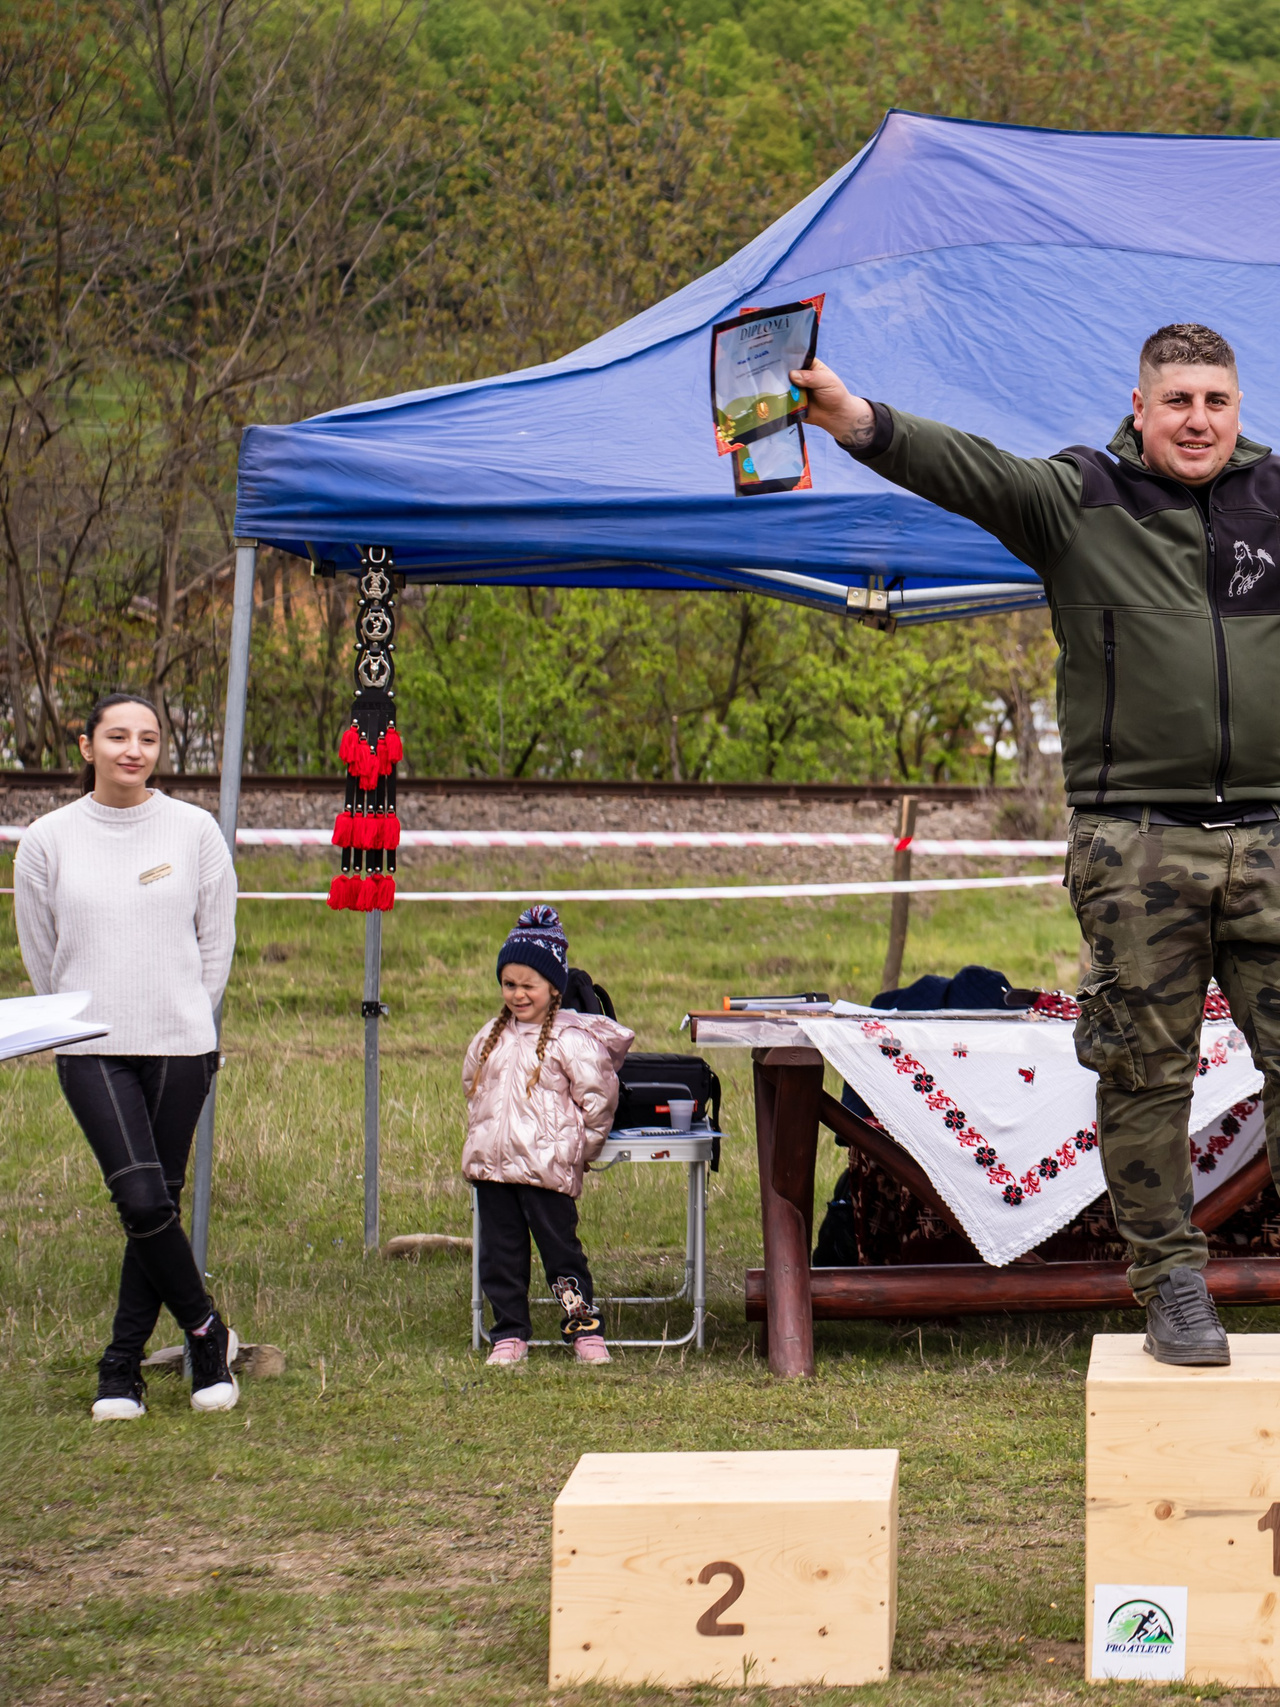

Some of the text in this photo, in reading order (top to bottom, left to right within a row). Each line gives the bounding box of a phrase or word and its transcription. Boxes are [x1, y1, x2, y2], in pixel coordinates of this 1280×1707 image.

[696, 1560, 745, 1636] 2
[1104, 1643, 1172, 1655] PRO ATLETIC
